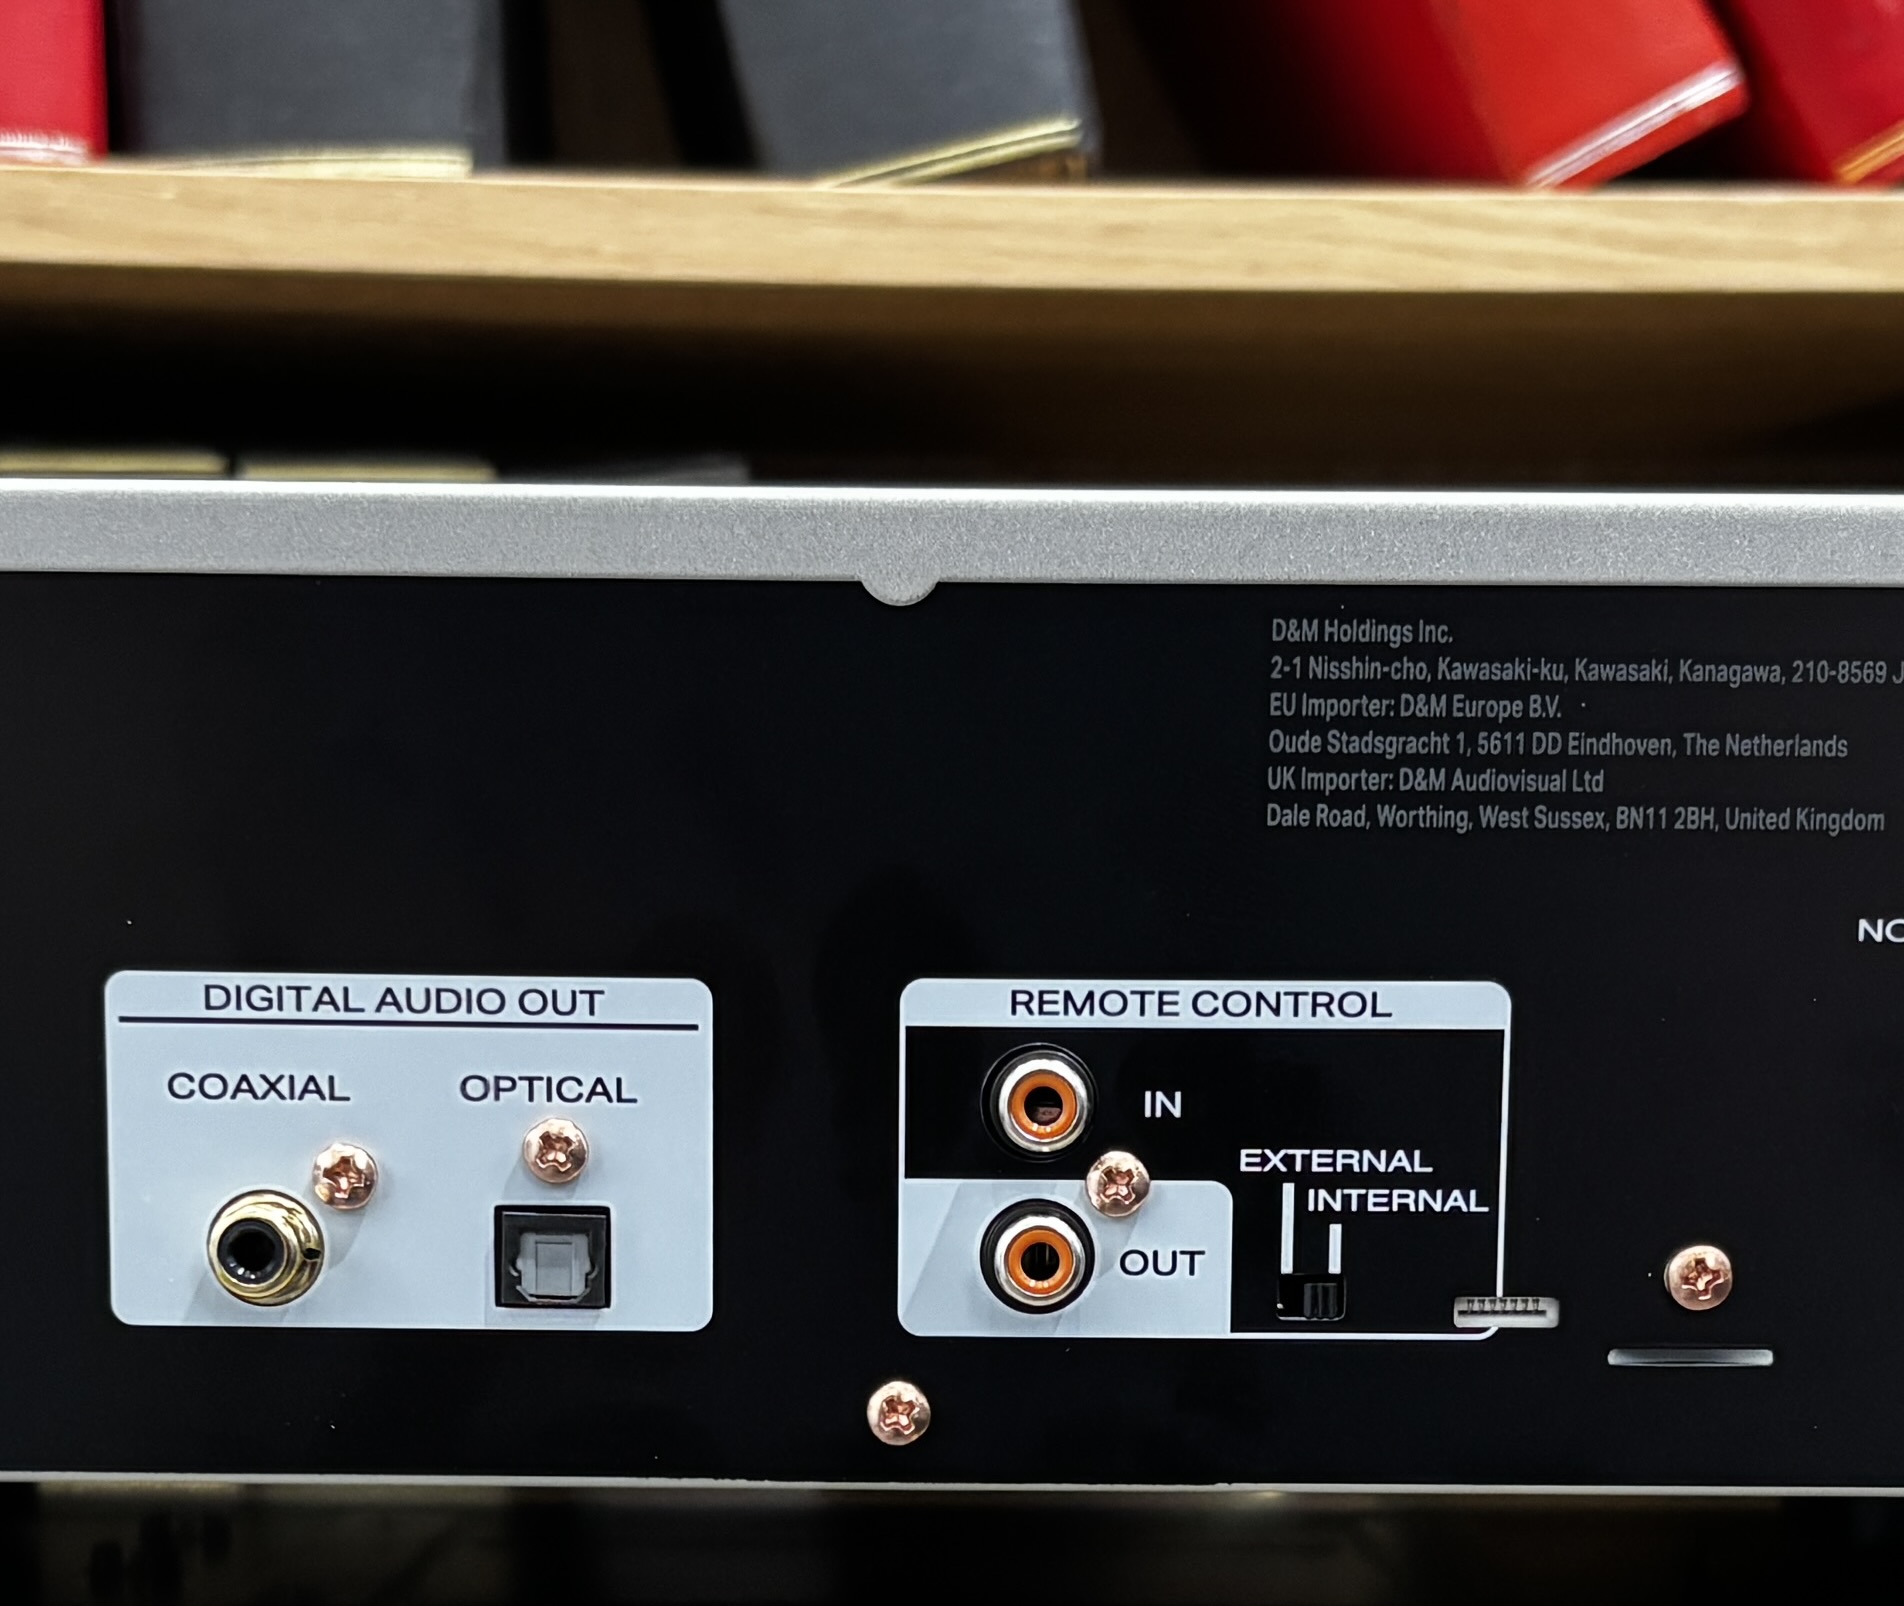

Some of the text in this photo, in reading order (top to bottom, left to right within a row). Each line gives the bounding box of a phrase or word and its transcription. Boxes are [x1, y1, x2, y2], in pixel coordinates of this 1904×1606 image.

[1273, 619, 1453, 648] D&M Holdings Inc.
[1271, 656, 1300, 678] 2-1
[1309, 656, 1431, 682] Nisshin-cho,
[1438, 657, 1568, 683] Kawasaki-ku,
[1575, 658, 1673, 684] Kawasaki,
[1680, 659, 1785, 688] Kanagawa,
[1792, 660, 1887, 683] 210-8569
[1271, 692, 1561, 723] EU Importer: D&M Europe B.V.
[1269, 729, 1847, 759] Oude Stadsgracht 1, 5611 DD Eindhoven, The Netherlands
[1268, 766, 1604, 796] UK Importer: D&M Audiovisual Ltd
[1267, 804, 1884, 836] Dale Road, Worthing, West Sussex, BN11 2BH, United Kingdom
[203, 984, 605, 1016] DIGITAL AUDIO OUT
[1011, 990, 1392, 1017] REMOTE CONTROL
[168, 1073, 350, 1101] COAXIAL
[460, 1075, 637, 1103] OPTICAL
[1145, 1091, 1181, 1118] IN
[1240, 1149, 1433, 1172] EXTERNAL
[1308, 1189, 1489, 1212] INTERNAL
[1120, 1250, 1205, 1276] OUT
